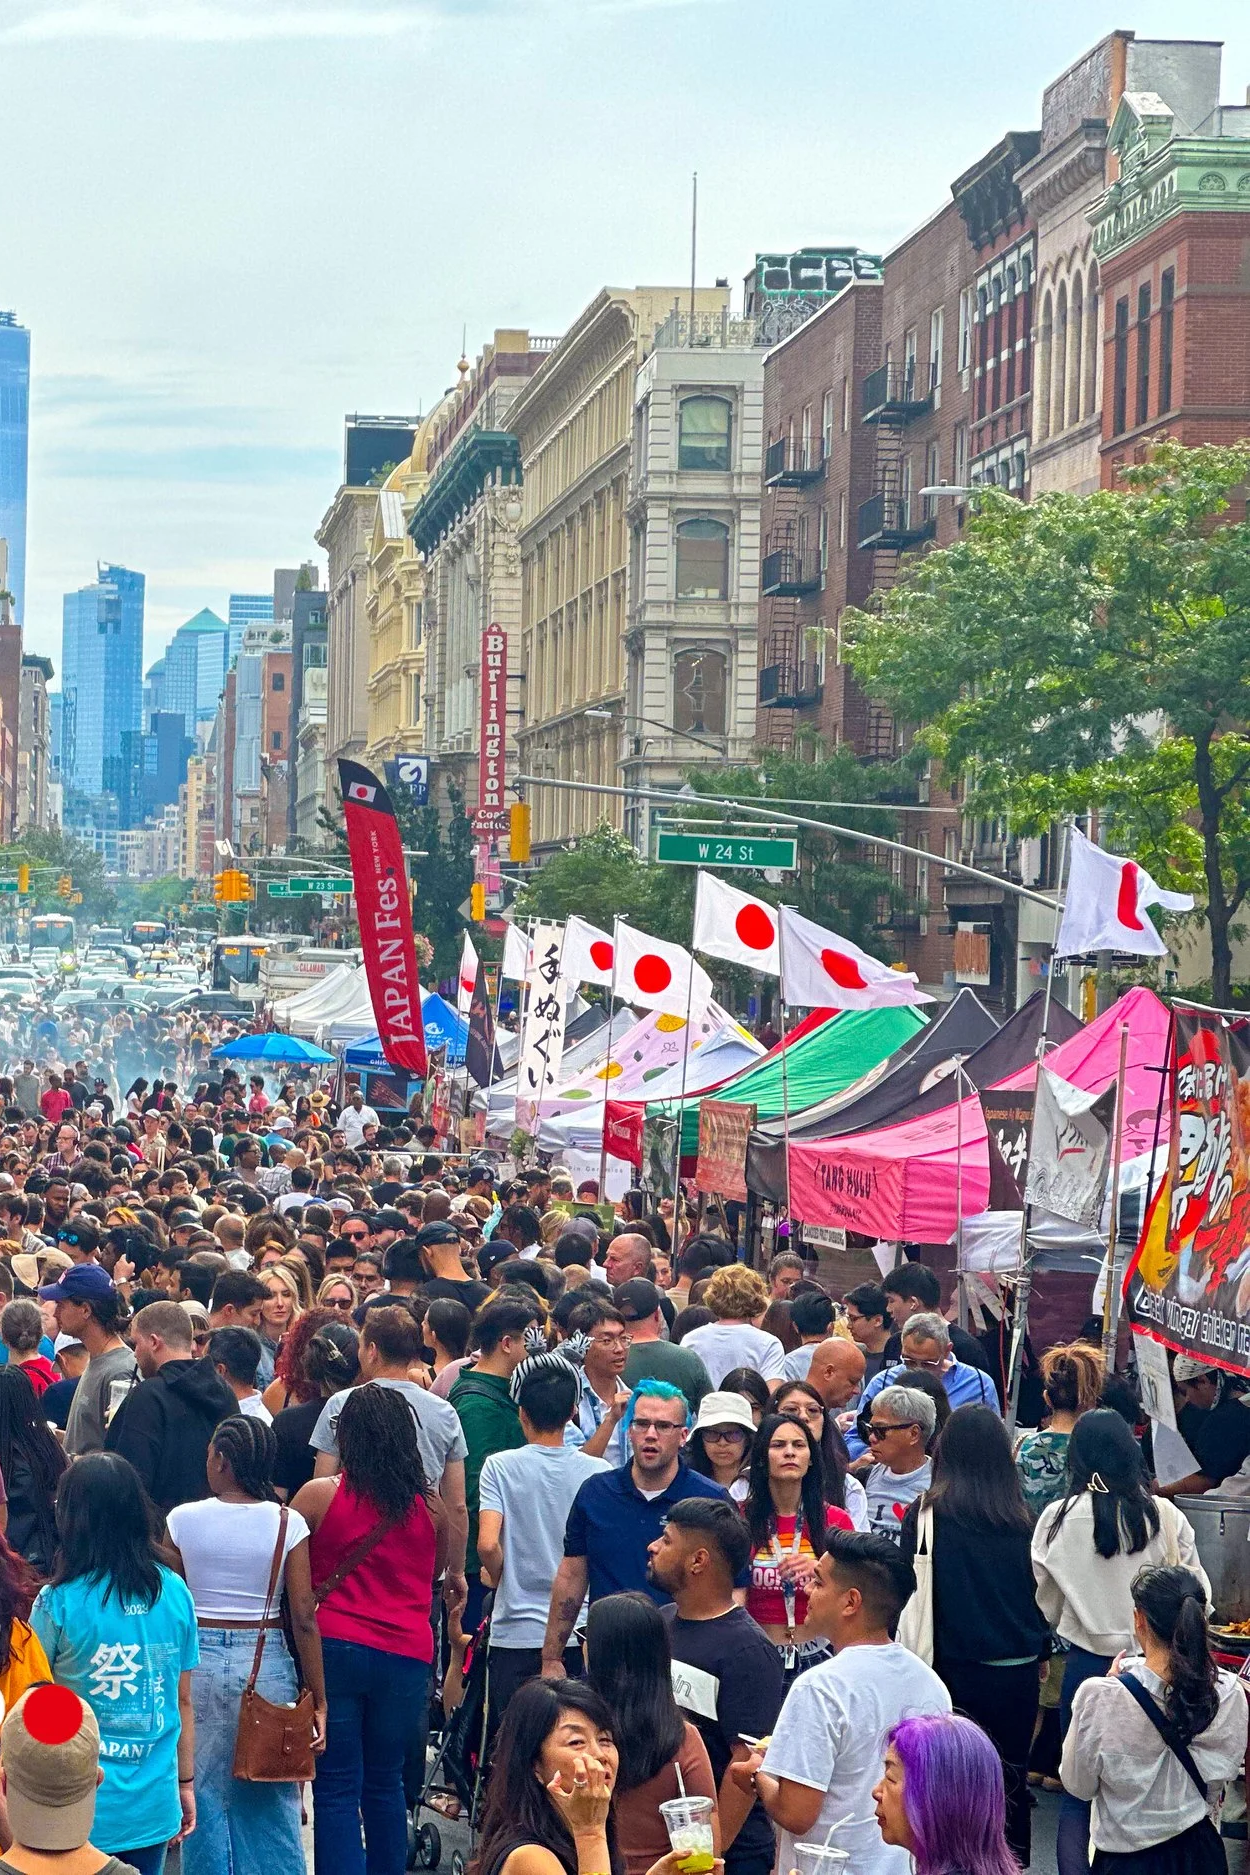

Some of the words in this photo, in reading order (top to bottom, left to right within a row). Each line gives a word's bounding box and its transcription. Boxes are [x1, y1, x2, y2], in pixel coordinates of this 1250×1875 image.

[484, 635, 505, 806] Burlington
[370, 830, 379, 854] YORK
[698, 843, 710, 859] W
[715, 844, 733, 860] 24
[739, 845, 754, 861] St
[308, 882, 314, 890] W
[316, 882, 325, 890] 23
[327, 882, 335, 890] St
[300, 963, 326, 973] CALAMARI
[377, 938, 420, 1045] JAPAN
[527, 943, 563, 1089] 手ぬぐい
[585, 1165, 624, 1174] Cermics
[820, 1164, 844, 1193] TANG
[846, 1166, 872, 1200] HULU
[875, 1504, 886, 1521] I
[88, 1641, 144, 1701] 祭
[153, 1671, 166, 1735] まつり
[100, 1742, 144, 1758] APAN
